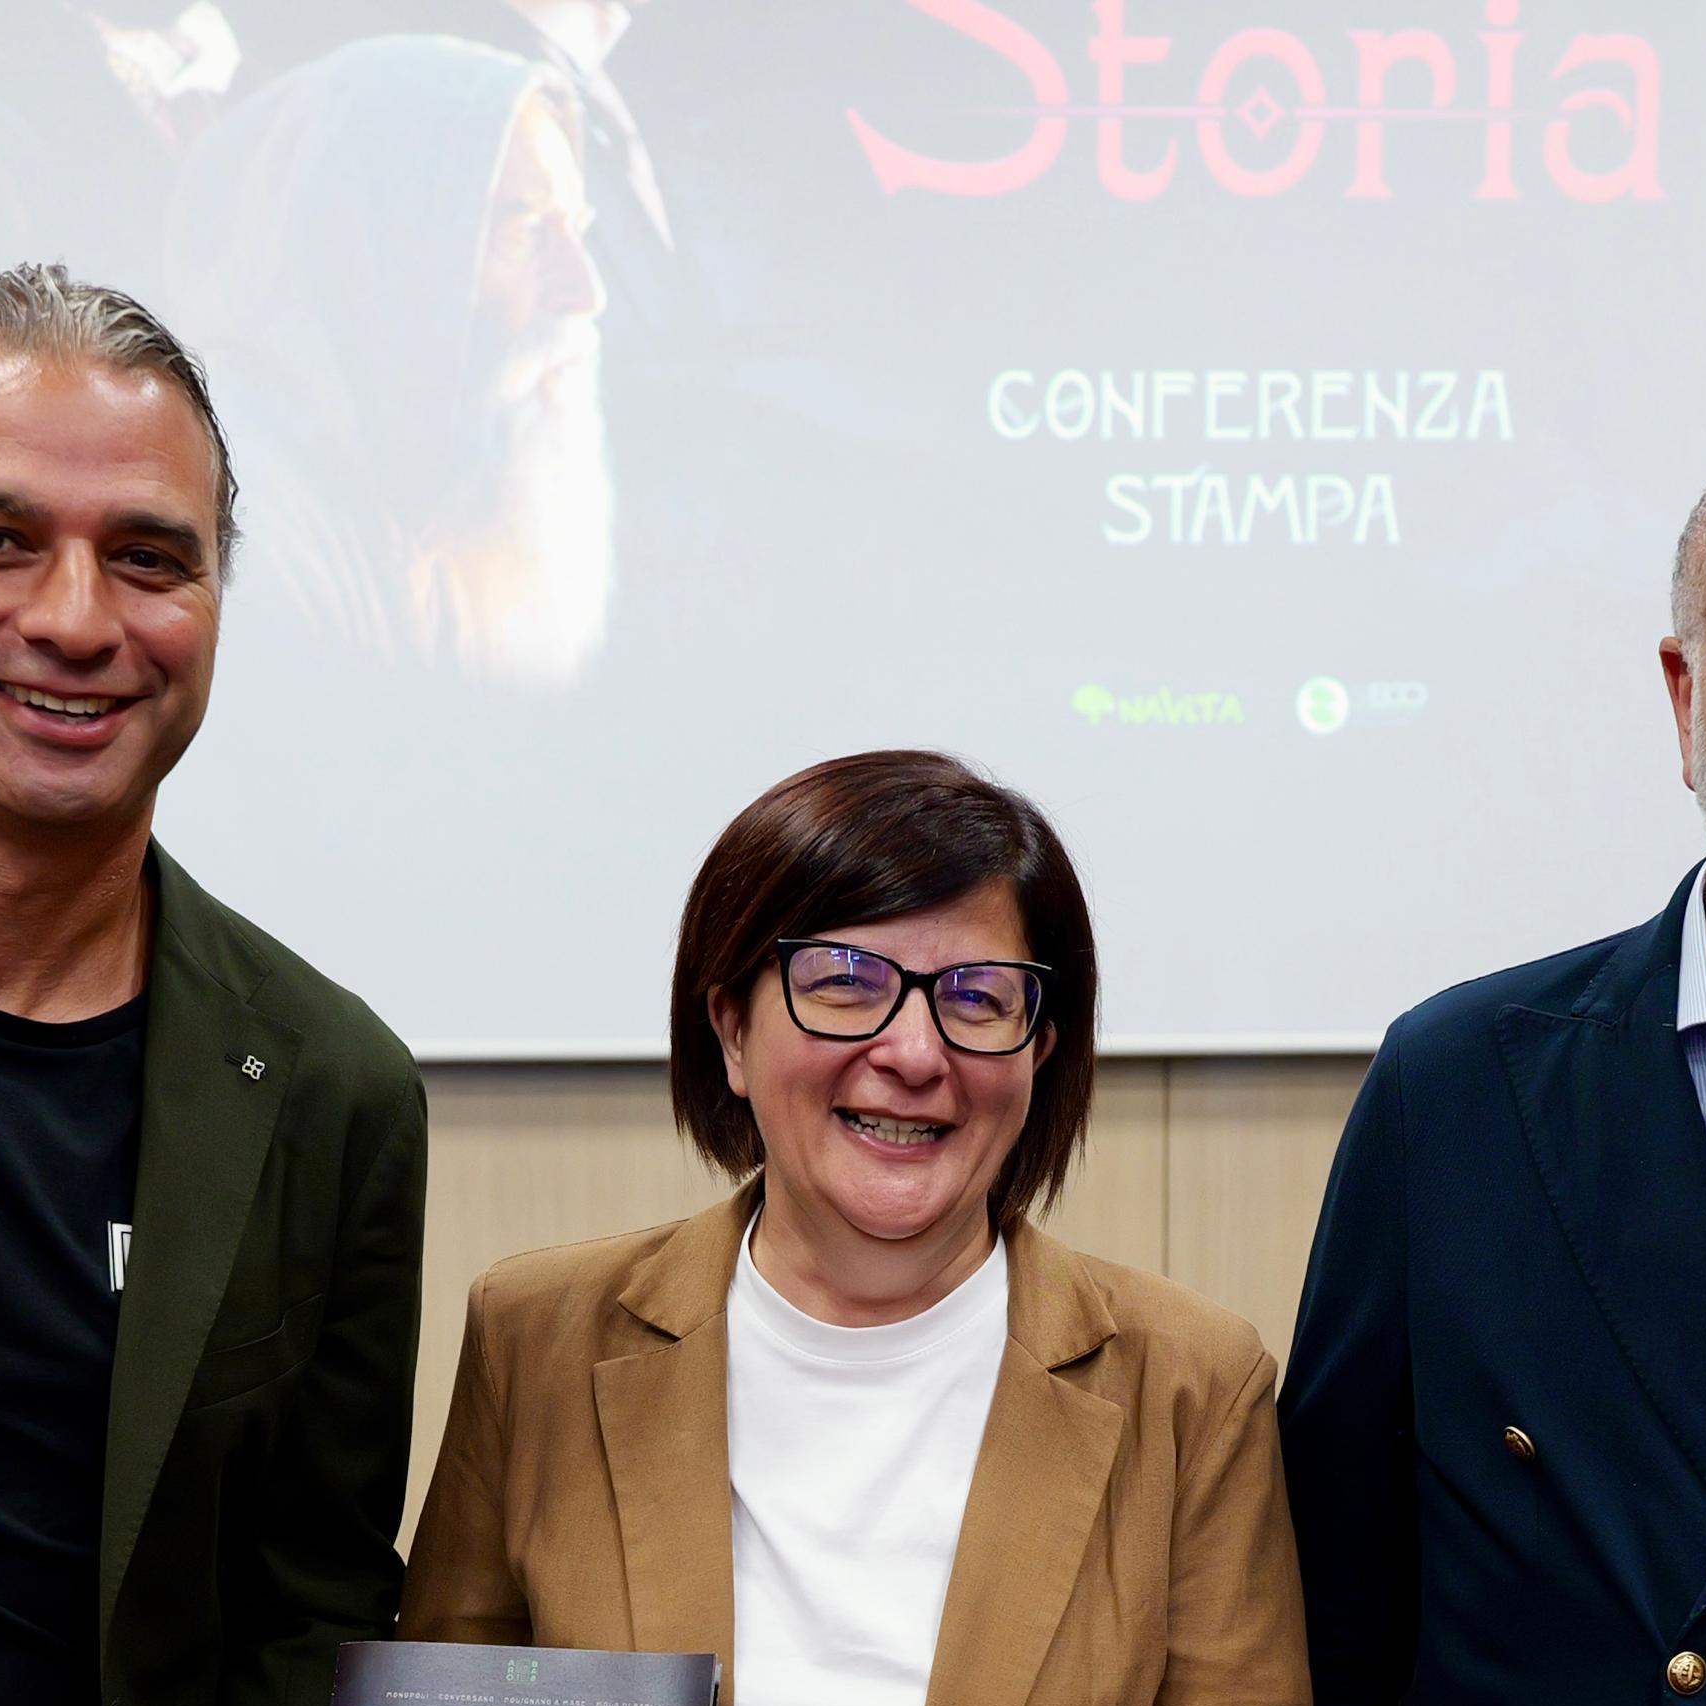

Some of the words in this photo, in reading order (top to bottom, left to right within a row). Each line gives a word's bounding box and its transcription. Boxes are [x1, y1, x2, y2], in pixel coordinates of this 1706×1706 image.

[844, 0, 1670, 202] Storia
[986, 367, 1515, 440] CONFERENZA
[1101, 463, 1401, 545] STAMPA
